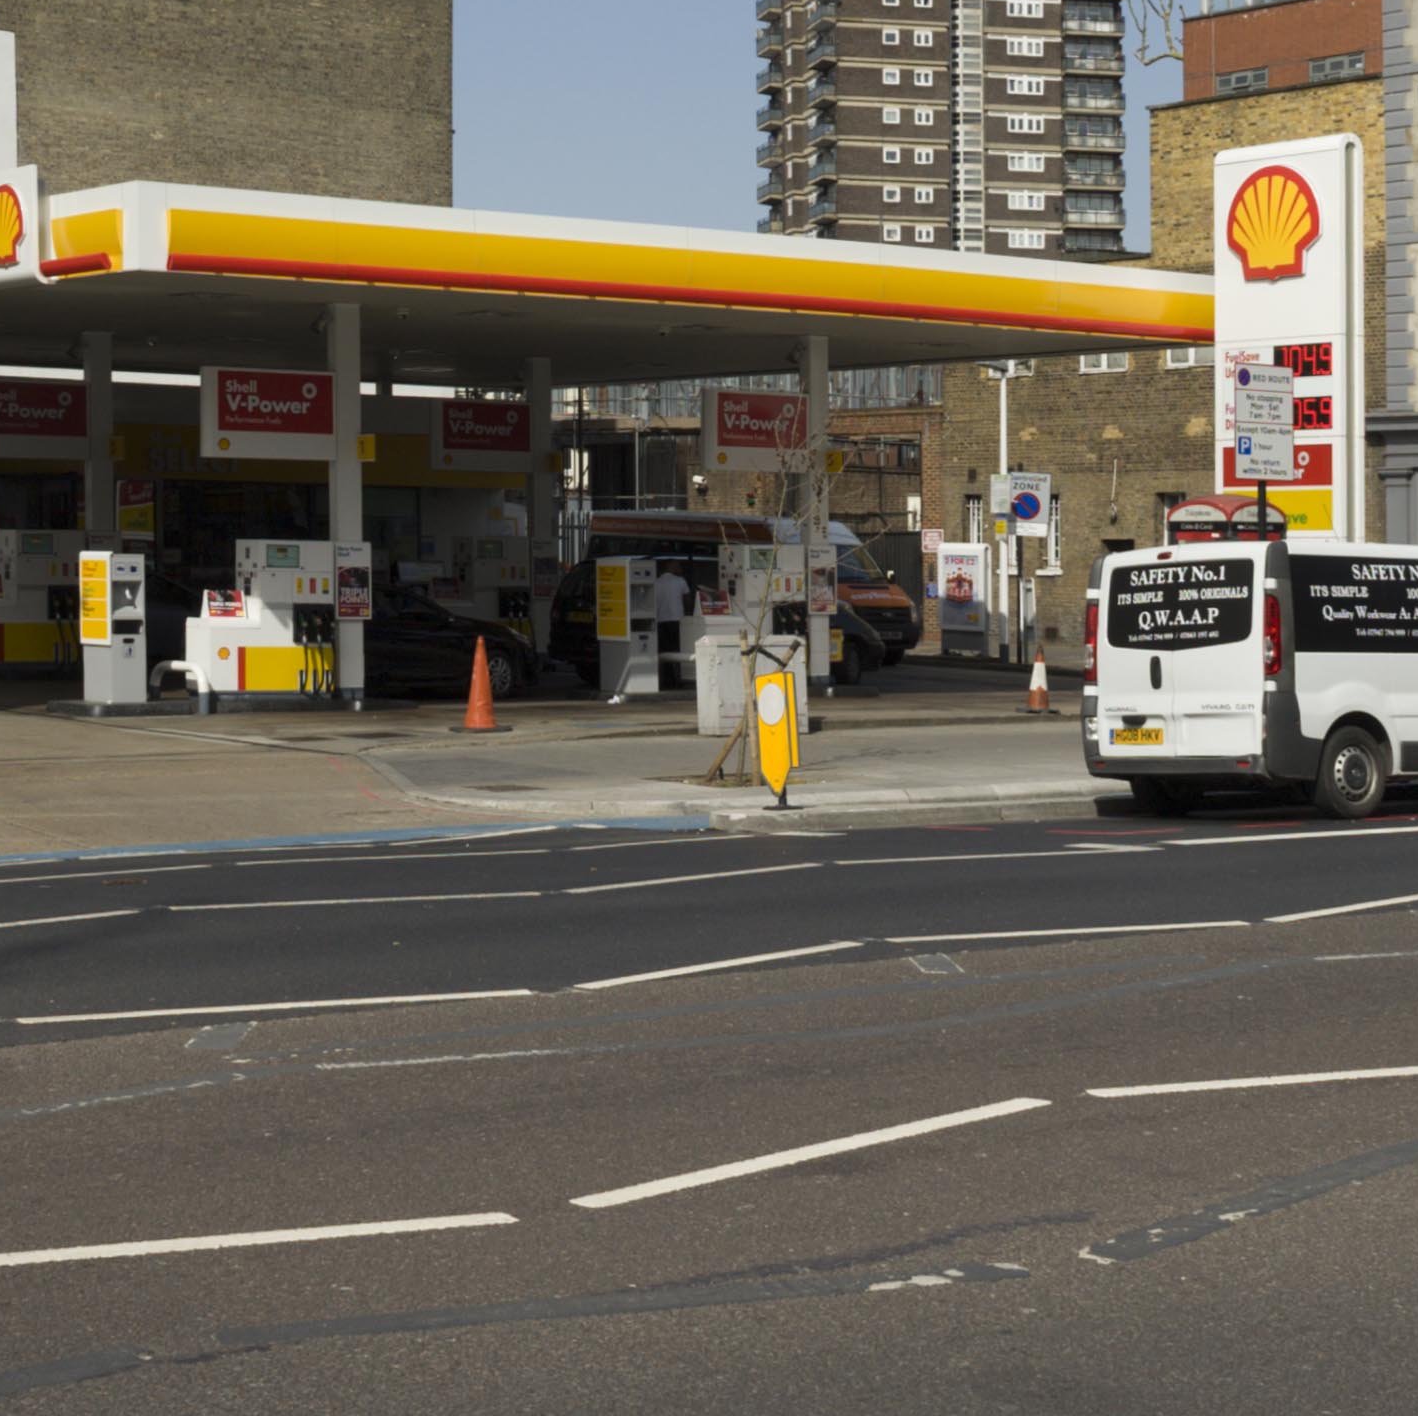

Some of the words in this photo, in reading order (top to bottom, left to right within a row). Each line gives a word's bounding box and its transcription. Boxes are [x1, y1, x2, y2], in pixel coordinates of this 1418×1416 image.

[1281, 343, 1332, 377] 104.9
[225, 379, 257, 394] Shell
[1253, 373, 1267, 383] RED
[1268, 375, 1291, 385] ROUTE
[225, 395, 311, 415] V-Power
[448, 407, 473, 420] Shell
[723, 400, 748, 413] Shell
[1293, 397, 1332, 430] 05.9
[449, 420, 514, 438] V-Power
[723, 413, 790, 433] V-Power
[1013, 482, 1041, 492] ZONE
[1130, 566, 1189, 587] SAFETY
[1191, 565, 1226, 583] No.1
[1351, 564, 1406, 581] SAFETY
[1117, 593, 1132, 606] ITS
[1133, 591, 1164, 605] SIMPLE
[1200, 586, 1249, 601] ORIGINALS
[1309, 585, 1329, 598] ITS
[1331, 585, 1369, 598] SIMPLE
[1138, 607, 1220, 631] Q.W.A.A.P
